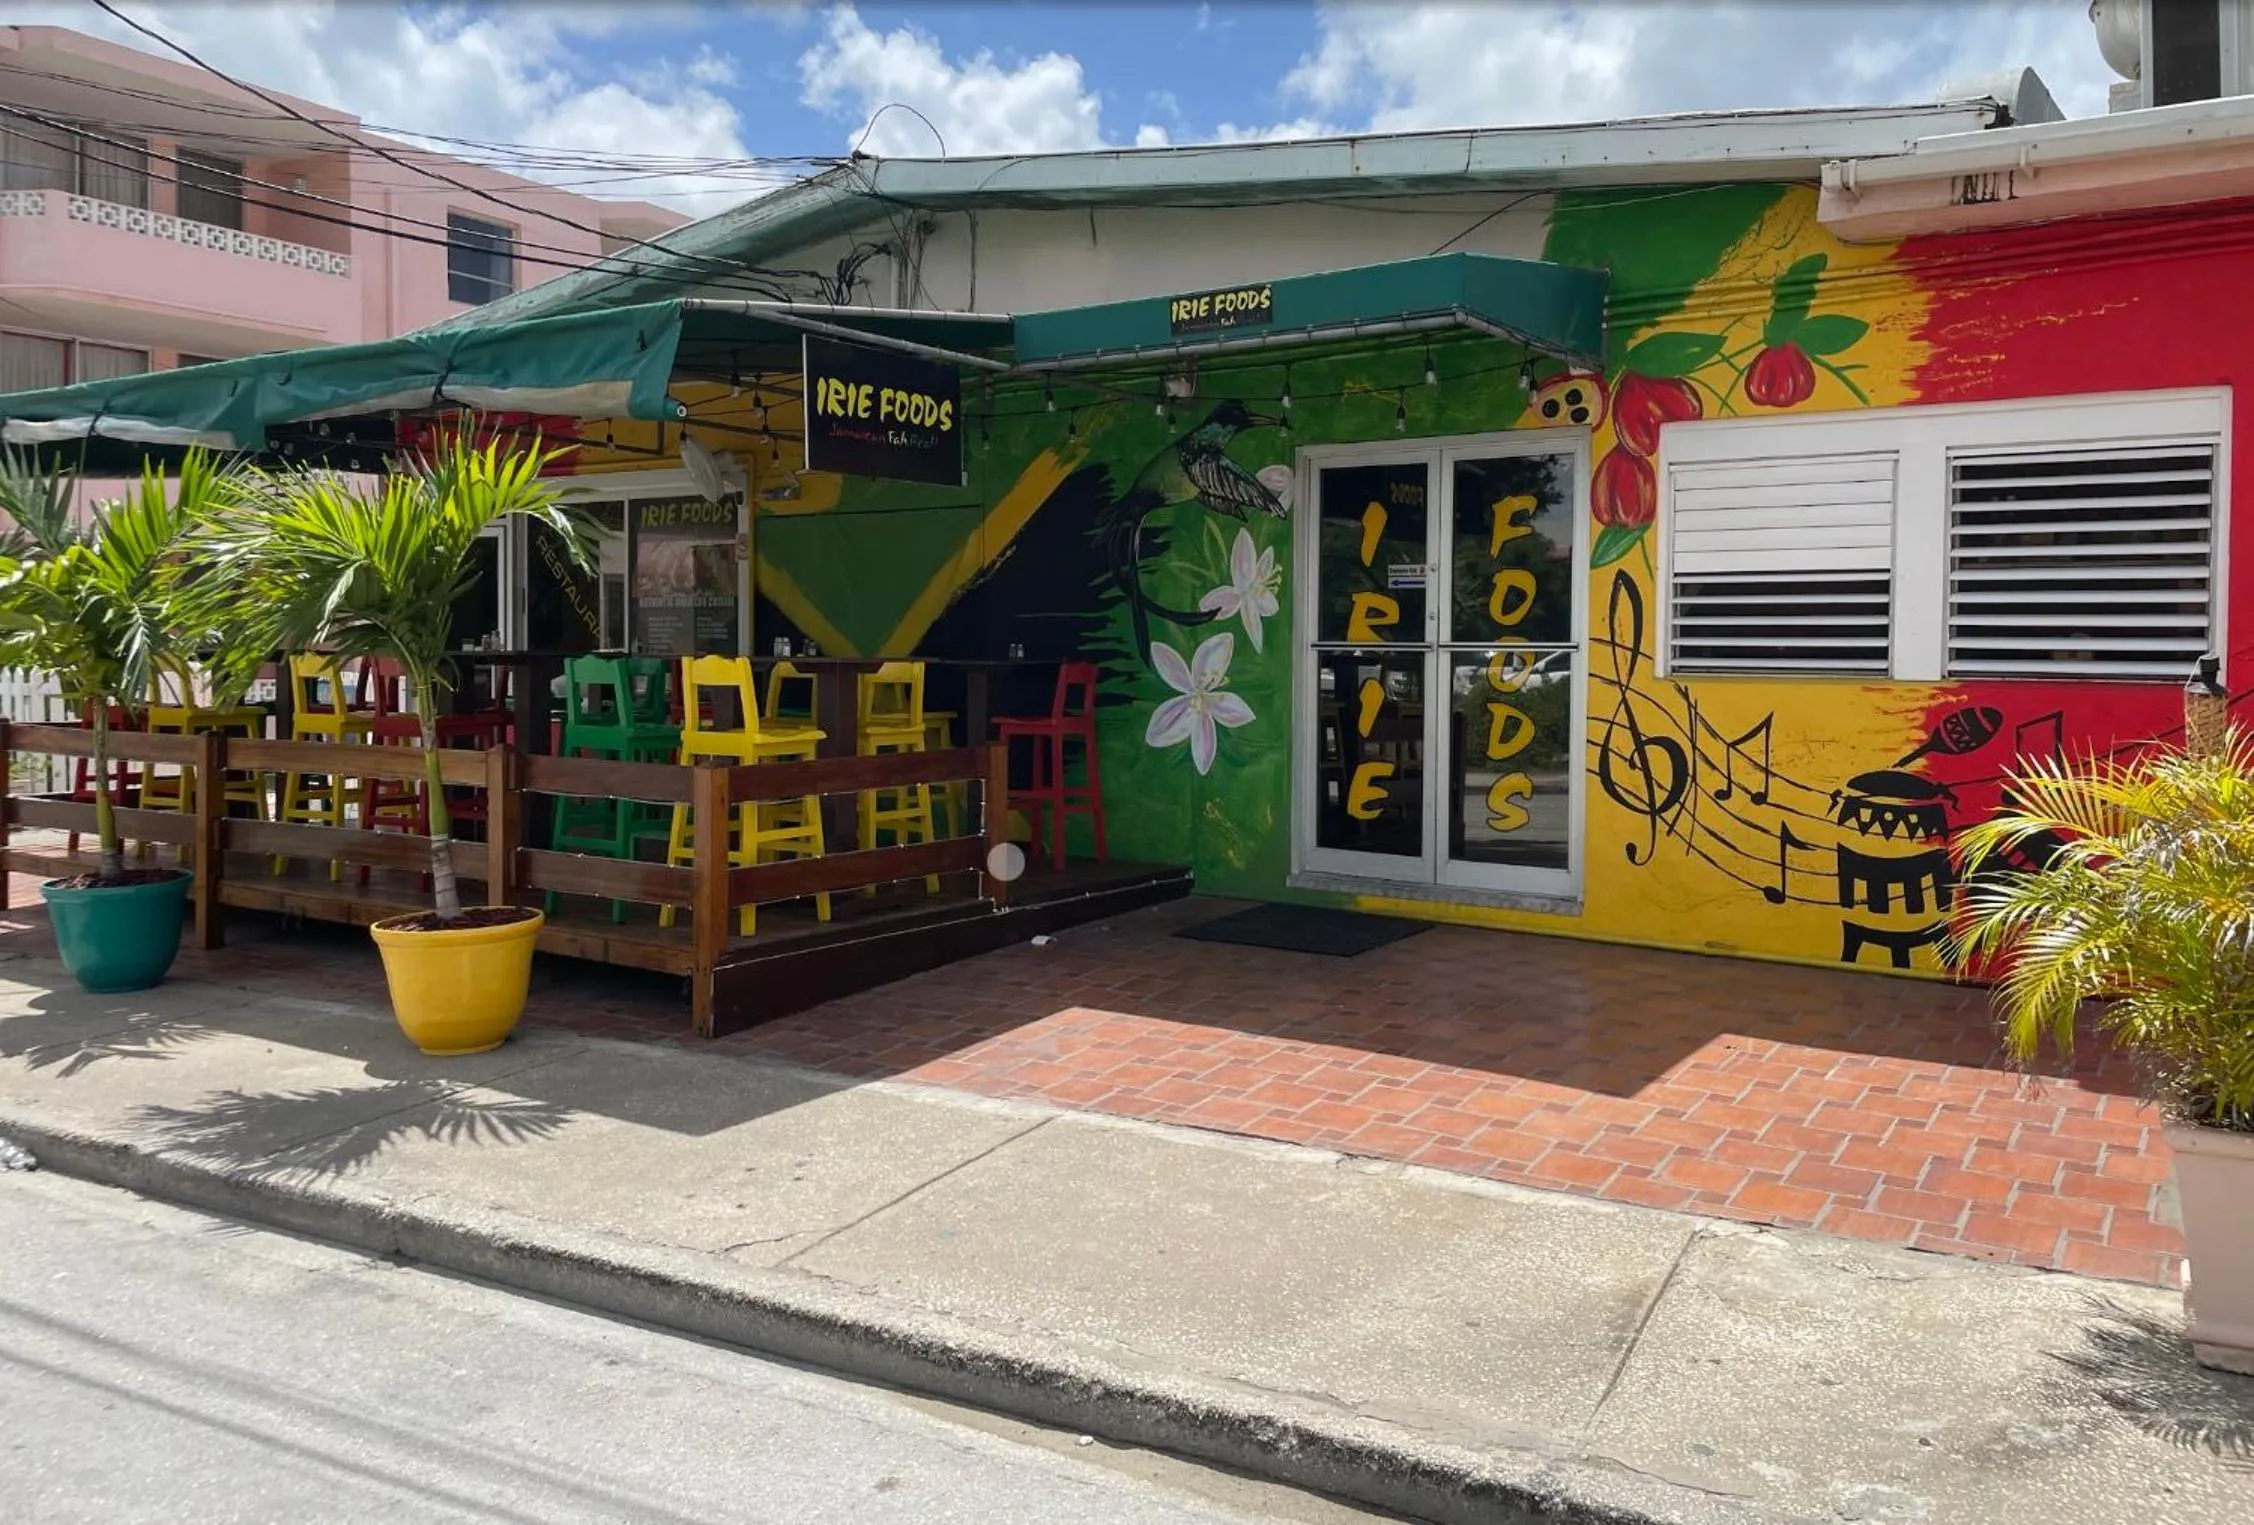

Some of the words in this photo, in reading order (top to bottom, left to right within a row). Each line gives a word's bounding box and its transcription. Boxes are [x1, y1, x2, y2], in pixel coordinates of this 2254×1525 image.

[1172, 296, 1210, 323] IRIE
[1215, 288, 1271, 315] FOODS
[817, 376, 874, 418] IRIE
[879, 388, 953, 431] FOODS
[641, 504, 676, 528] IRIE
[681, 502, 733, 525] FOODS
[1346, 501, 1400, 820] IRIE
[1486, 495, 1539, 832] FOODS
